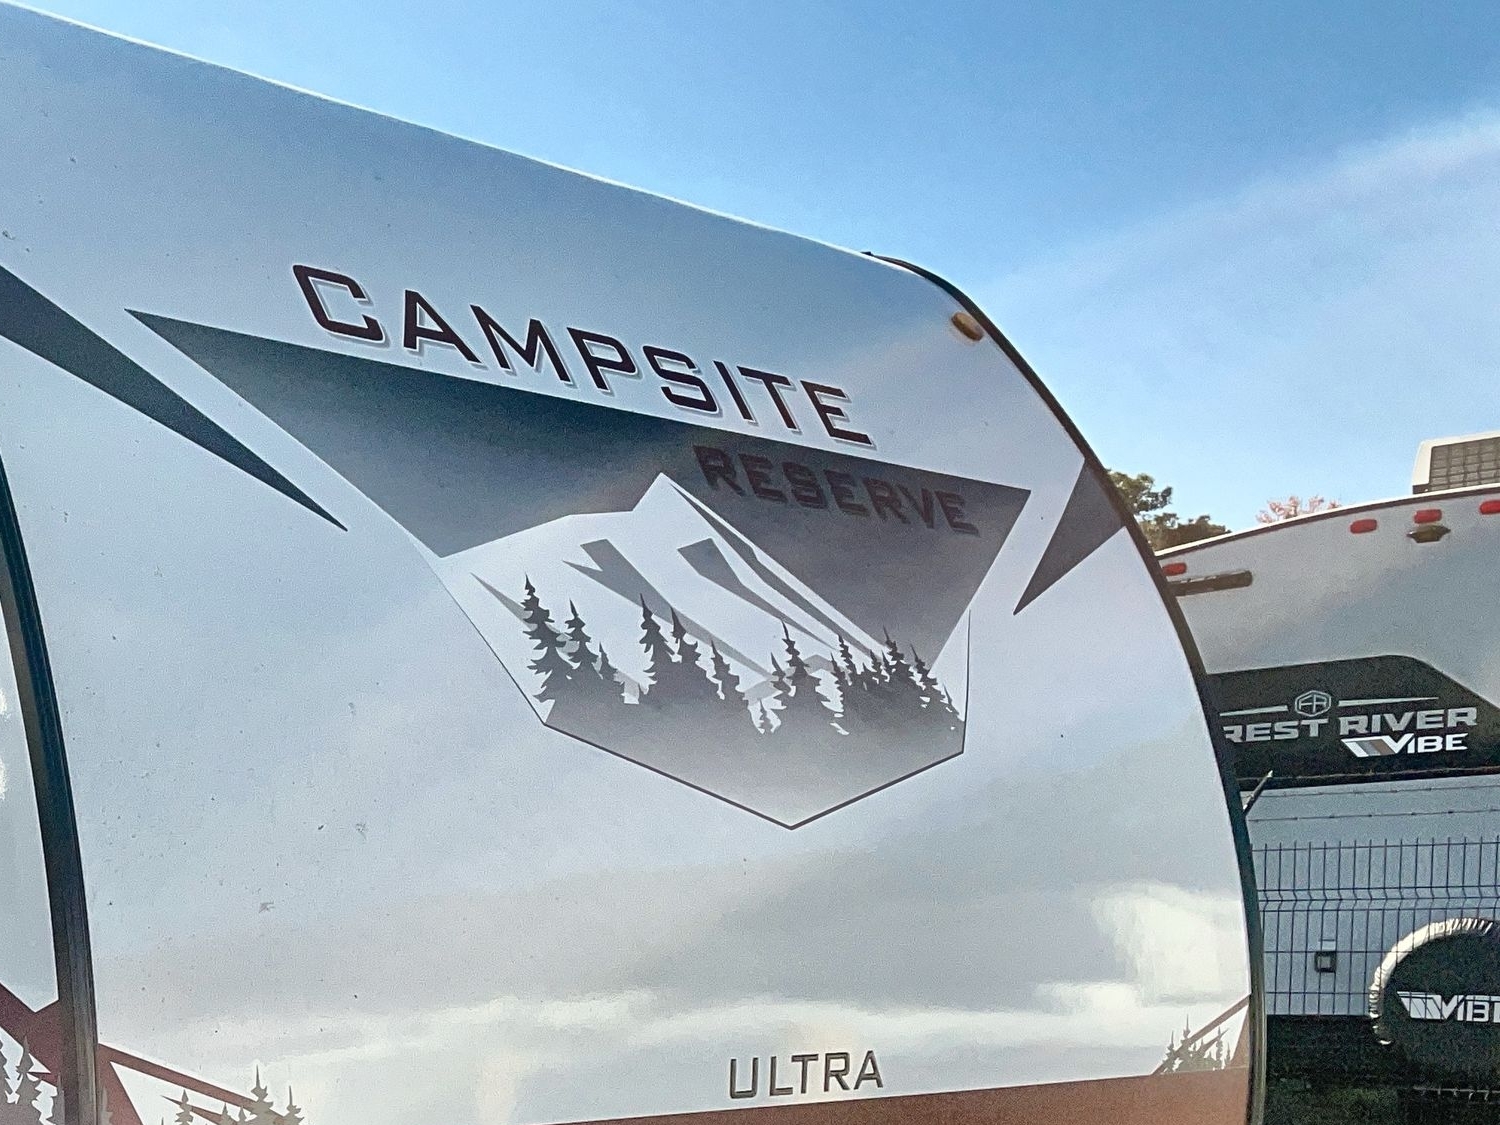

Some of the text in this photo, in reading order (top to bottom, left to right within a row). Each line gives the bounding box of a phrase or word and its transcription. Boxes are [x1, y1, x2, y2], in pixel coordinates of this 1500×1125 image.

[292, 263, 876, 448] CAMPSITE
[693, 445, 981, 537] RESERVE
[1338, 707, 1478, 735] RIVER
[1341, 732, 1469, 758] VIBE
[728, 1049, 884, 1100] ULTRA
